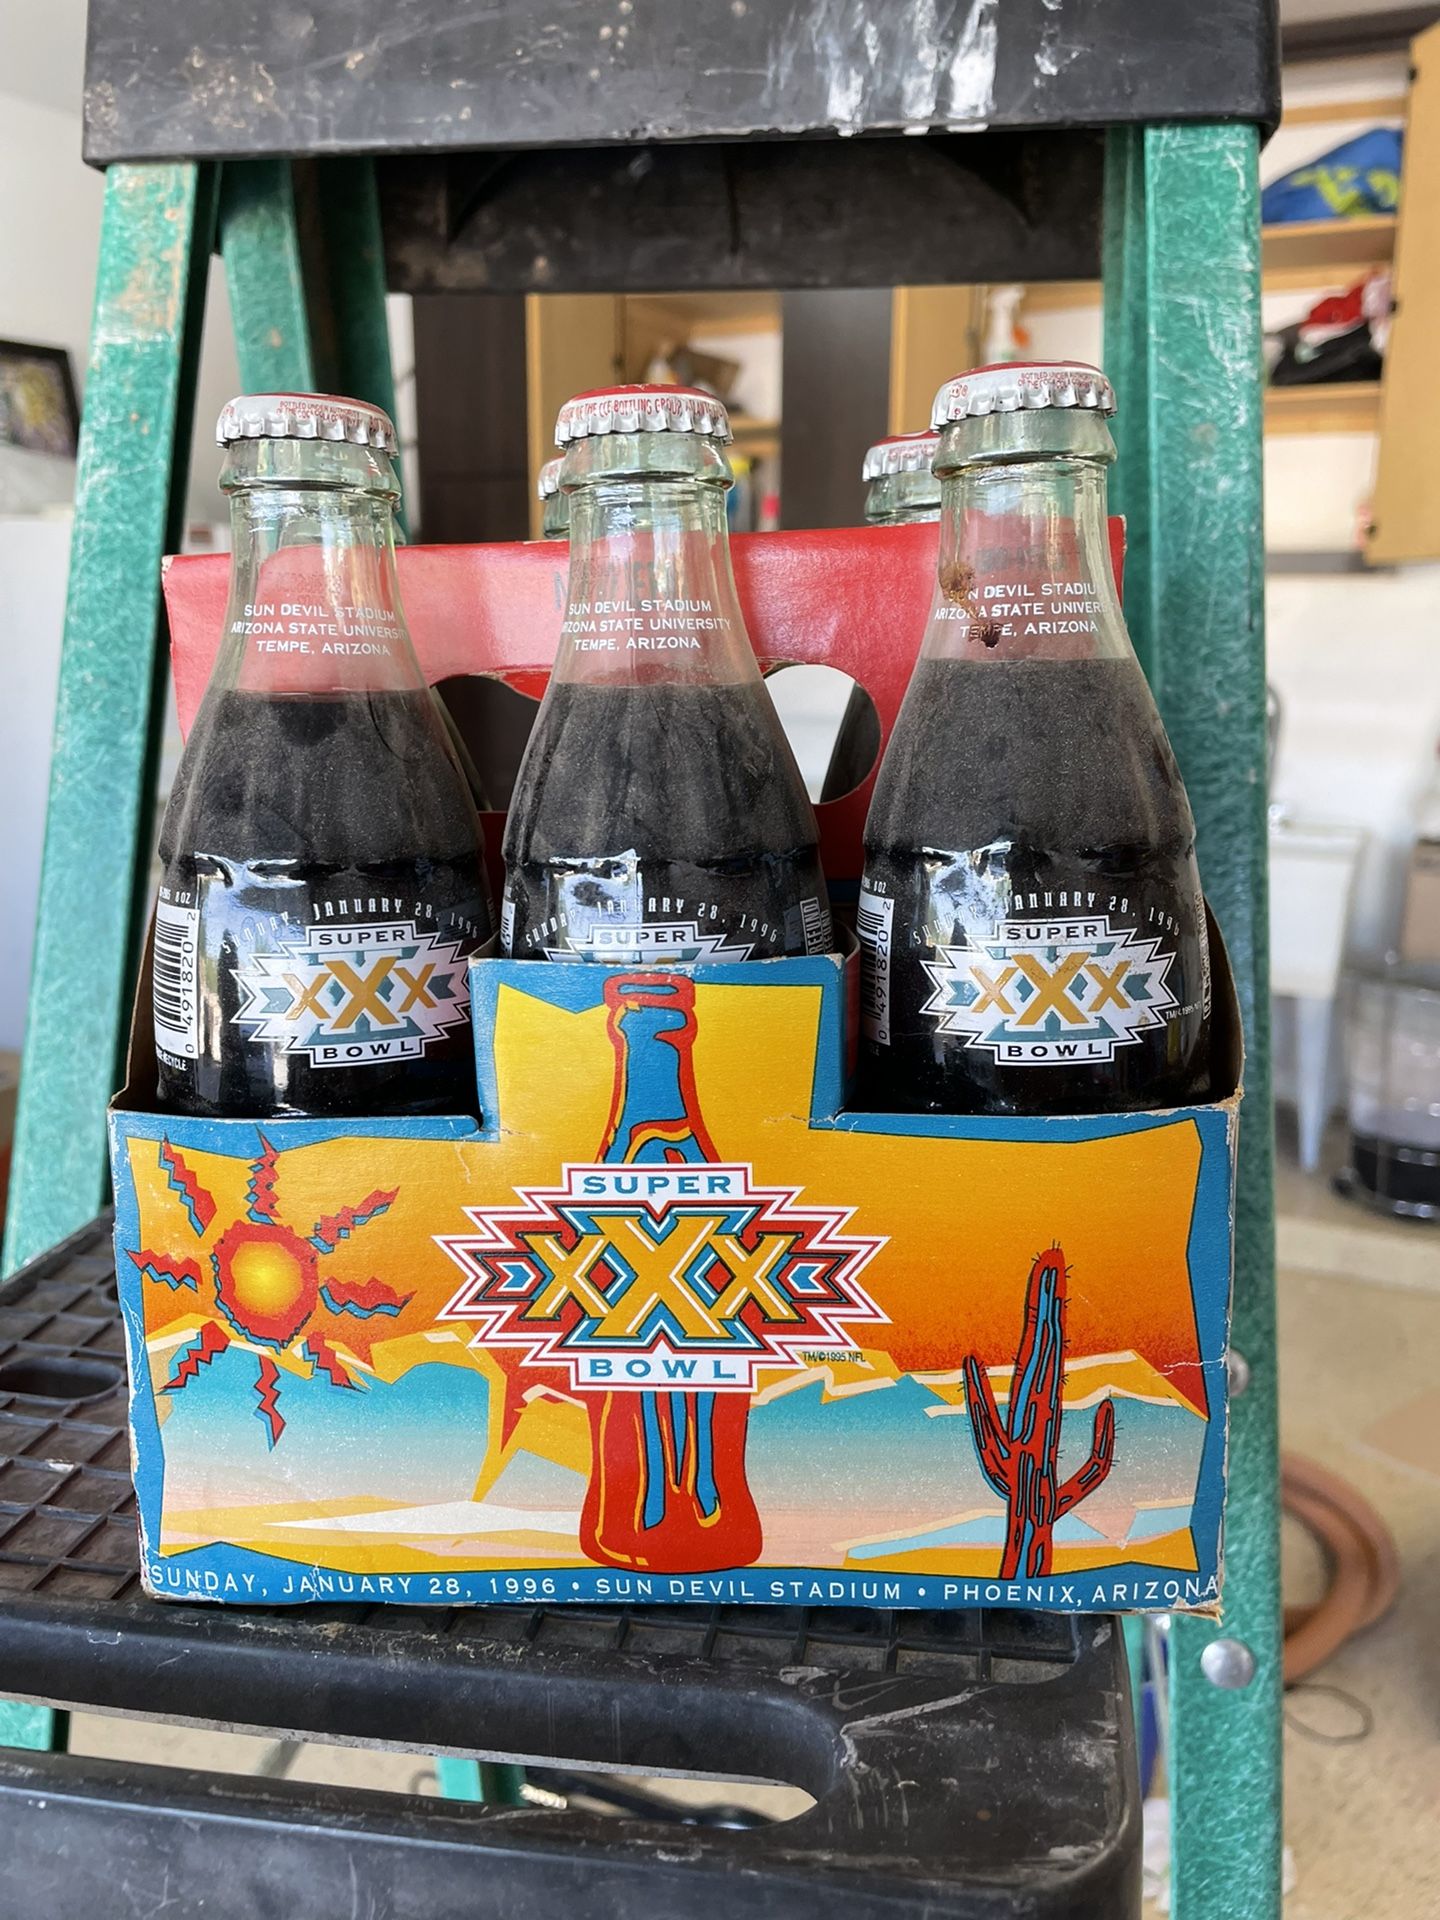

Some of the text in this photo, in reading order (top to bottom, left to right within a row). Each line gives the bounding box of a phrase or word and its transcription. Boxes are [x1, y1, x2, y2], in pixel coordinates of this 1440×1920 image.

[1020, 371, 1049, 380] BOTTLED
[279, 400, 307, 409] BOTTLED
[613, 398, 652, 417] BOTTLING
[983, 584, 1035, 599] DEVIL
[1041, 582, 1097, 596] STADIU
[244, 603, 396, 622] SUN DEVIL STADIUM
[569, 599, 712, 615] SUN DEVIL STADIUM
[991, 602, 1045, 617] STATE
[231, 620, 284, 635] ARIZONA
[289, 622, 339, 636] STATE
[600, 617, 644, 632] STATE
[650, 617, 732, 632] UNIVERSITY
[1024, 620, 1100, 635] ARIZONA
[256, 640, 392, 657] TEMPE, ARIZONA
[574, 636, 702, 652] TEMPE, ARIZONA
[221, 910, 302, 955] SUNDAY,
[313, 897, 403, 921] JANUARY
[450, 912, 479, 939] 1996
[739, 913, 778, 944] 1996
[805, 903, 824, 953] REFUND
[1006, 924, 1099, 941] SUPER
[319, 929, 406, 946] SUPER
[599, 929, 687, 945] SUPER
[876, 929, 890, 1017] 491820
[181, 940, 195, 1028] 491820
[969, 952, 1132, 1026] XXX
[282, 956, 438, 1030] XXX
[323, 1043, 415, 1060] BOWL
[1006, 1042, 1103, 1058] BOWL
[582, 1174, 732, 1196] SUPER
[515, 1214, 805, 1340] XXX
[848, 1352, 866, 1363] NFL
[589, 1358, 737, 1380] BOWL
[152, 1565, 1218, 1607] SUNDAY, JANUARY 28, 1996 SUN DEVIL STADIUM PHOENIX, ARIZONA
